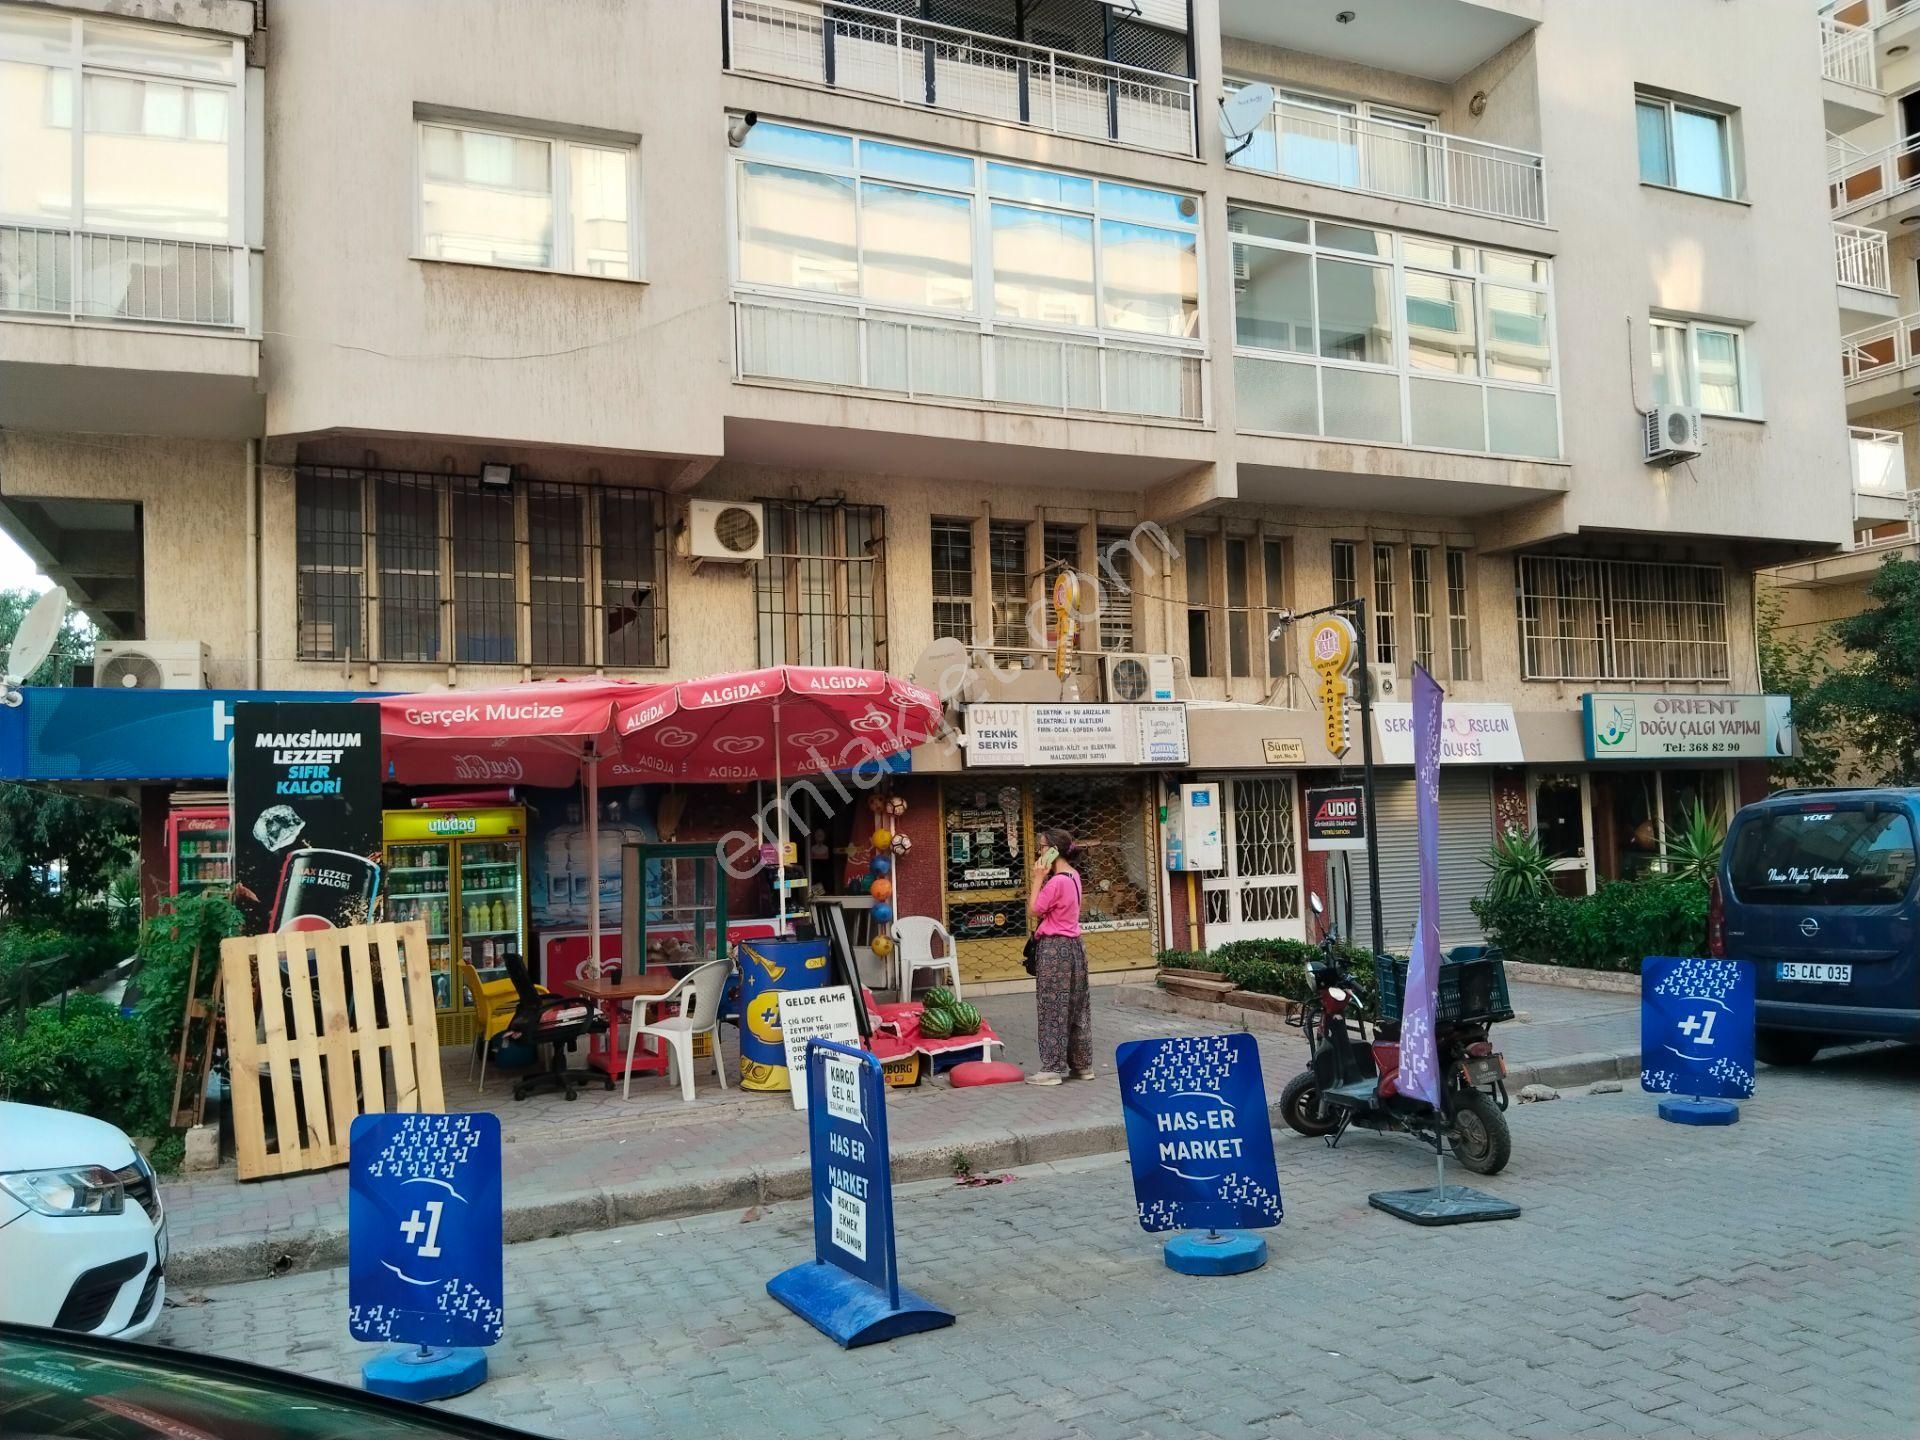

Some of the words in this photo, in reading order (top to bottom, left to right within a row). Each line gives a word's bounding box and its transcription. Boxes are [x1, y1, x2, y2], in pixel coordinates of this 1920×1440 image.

[405, 707, 480, 726] Gerçek
[485, 701, 565, 722] Mucize
[1325, 671, 1336, 747] ANAHTARCI
[1653, 698, 1740, 715] ORIENT
[973, 709, 1021, 726] UMUT
[977, 729, 1018, 739] TEKNİK
[1640, 717, 1677, 736] DOĞU
[1679, 720, 1715, 739] ÇALGI
[1719, 719, 1761, 734] YAPIMI
[255, 729, 361, 748] MAKSİMUM
[978, 739, 1018, 750] SERVİS
[1267, 741, 1300, 751] Sümer
[1662, 742, 1686, 752] Tel:
[1688, 742, 1709, 752] 368
[1711, 742, 1725, 752] 82
[1727, 742, 1741, 752] 90
[273, 750, 343, 764] LEZZET
[288, 765, 330, 779] SIFIR
[276, 777, 341, 794] KALORİ
[1313, 798, 1358, 820] AUDIO
[319, 868, 352, 881] LEZZET
[1782, 964, 1796, 978] 35
[1801, 964, 1822, 979] CAC
[1827, 966, 1849, 981] 035
[785, 996, 817, 1007] GELDE
[819, 992, 846, 1004] ALMA
[1677, 1010, 1716, 1044] +1
[830, 1065, 855, 1086] KARGO
[831, 1085, 845, 1100] GEL
[846, 1088, 856, 1103] AL
[1156, 1109, 1236, 1132] HAS-ER
[830, 1132, 850, 1158] HAS
[852, 1138, 866, 1164] ER
[1158, 1138, 1243, 1161] MARKET
[828, 1165, 869, 1199] MARKET
[837, 1196, 860, 1217] ASKIDA
[400, 1201, 443, 1257] +1
[839, 1213, 858, 1232] EKMEK
[836, 1231, 862, 1252] BULUNUR
